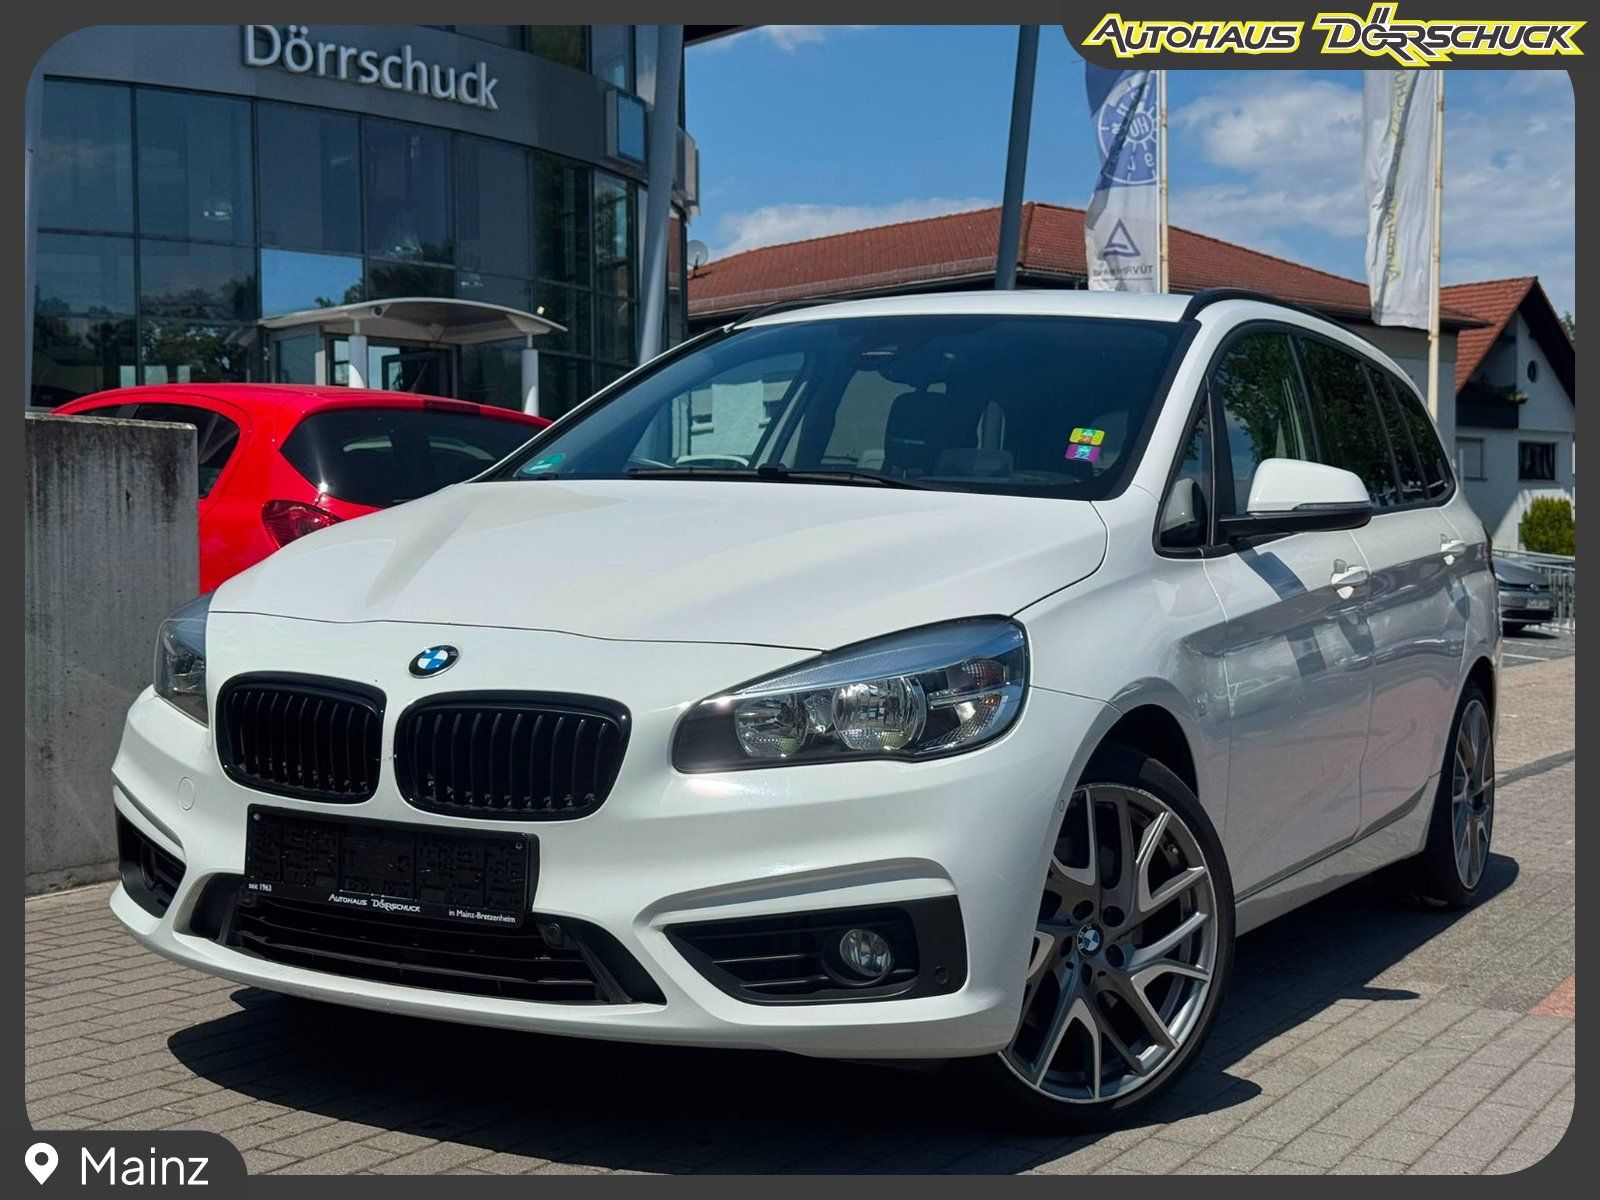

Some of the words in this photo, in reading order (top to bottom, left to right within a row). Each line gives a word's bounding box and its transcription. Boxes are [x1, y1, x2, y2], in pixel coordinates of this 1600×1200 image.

[244, 24, 499, 109] Dörrschuck
[328, 893, 368, 907] AUTOHAUS
[456, 909, 516, 924] Mainz-Bretzenheim
